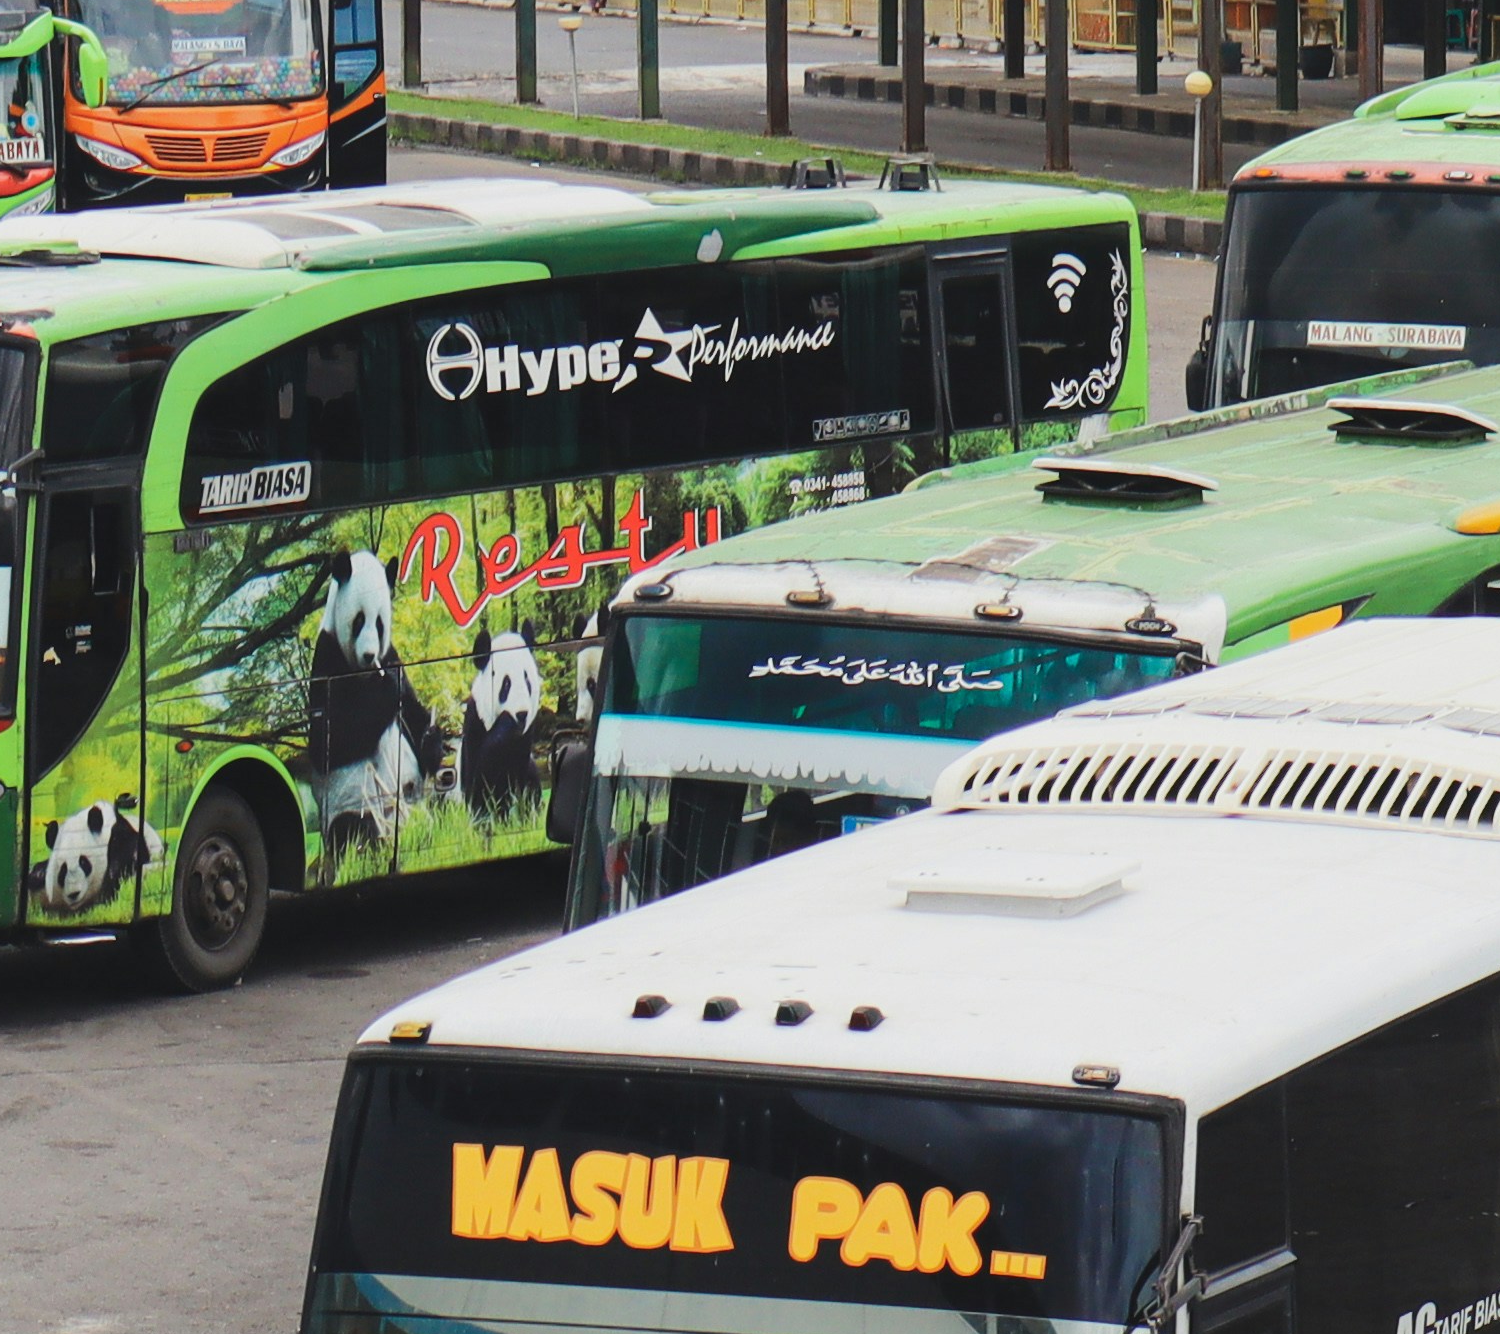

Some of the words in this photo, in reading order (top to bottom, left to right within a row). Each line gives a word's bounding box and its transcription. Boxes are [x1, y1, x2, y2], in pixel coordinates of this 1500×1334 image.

[688, 317, 836, 382] Performance
[1310, 324, 1373, 343] MALANG
[1387, 326, 1463, 347] SURABAYA
[200, 472, 252, 508] TARIP
[252, 465, 306, 501] BIASA
[451, 1142, 736, 1254] MASUK
